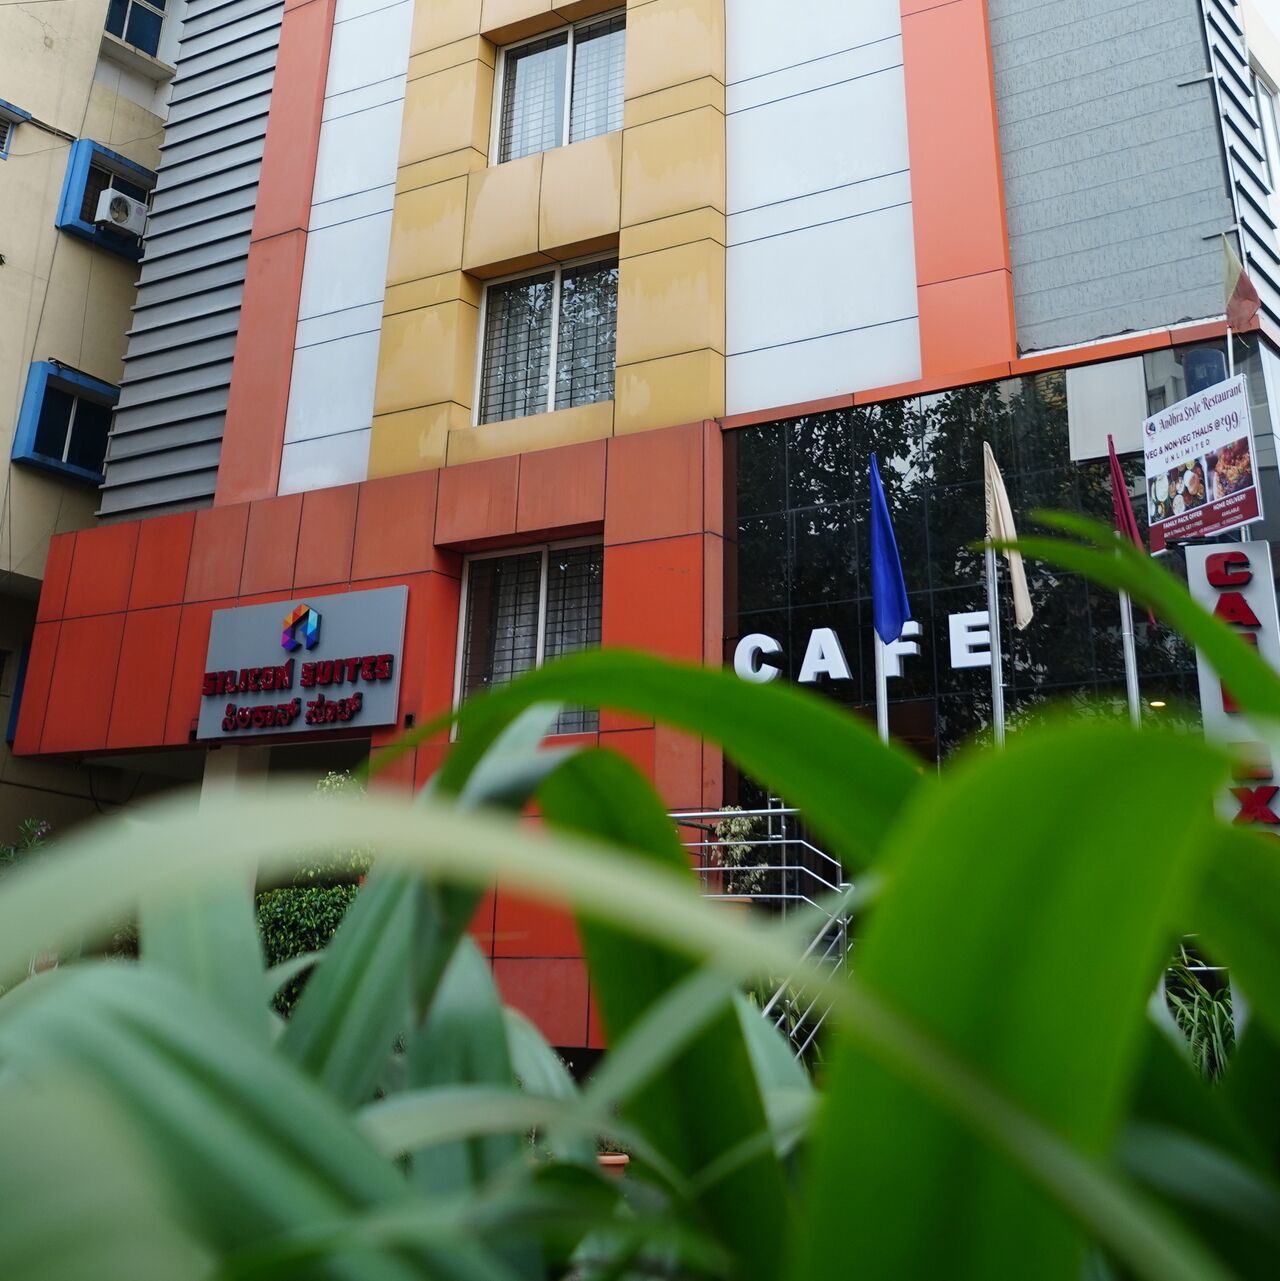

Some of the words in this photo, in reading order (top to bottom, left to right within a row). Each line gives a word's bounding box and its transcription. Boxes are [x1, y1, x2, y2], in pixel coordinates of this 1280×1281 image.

[1158, 414, 1184, 432] Andhra
[1184, 402, 1201, 420] Style
[1201, 384, 1242, 410] Restaurant
[1145, 451, 1158, 460] VEG
[1164, 435, 1191, 452] NON-VEG
[1191, 424, 1213, 439] THALIS
[1165, 439, 1210, 464] UNLIMITED
[734, 610, 992, 683] CAFE
[202, 658, 295, 696] SILICON
[300, 654, 394, 687] SUITES
